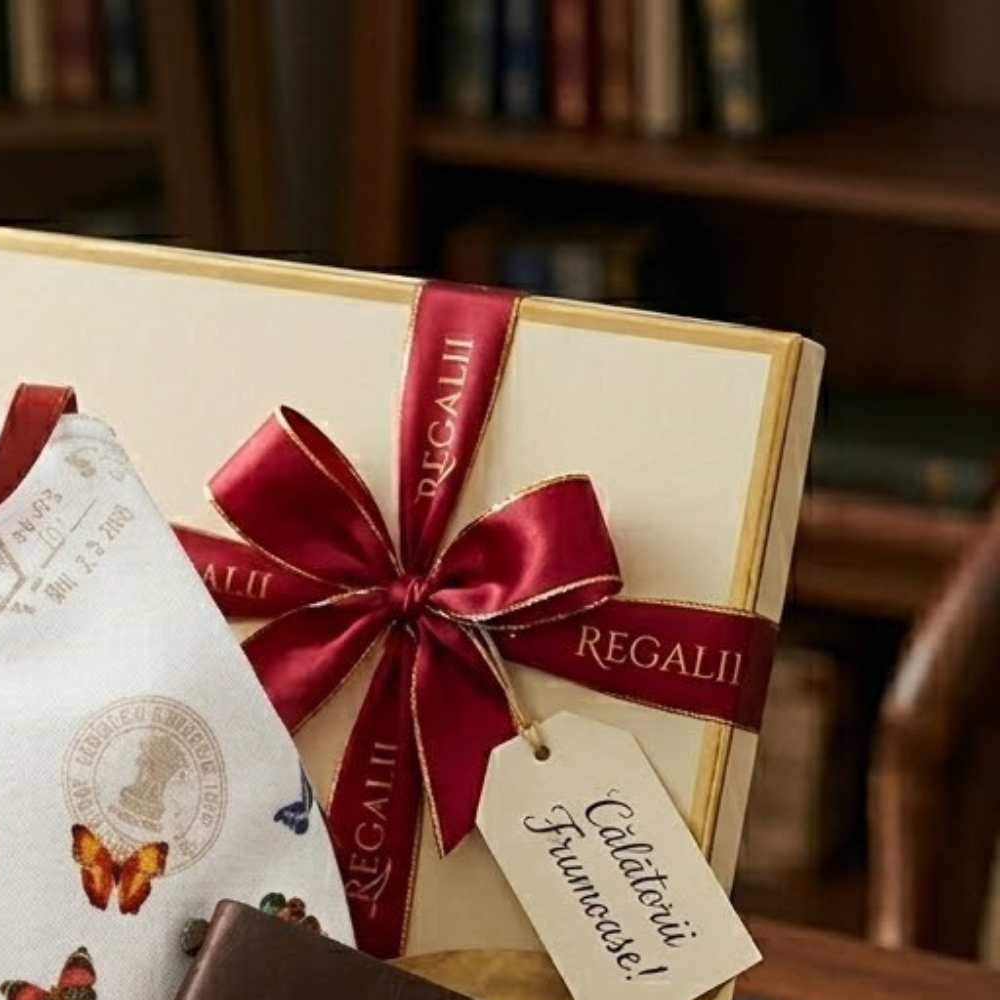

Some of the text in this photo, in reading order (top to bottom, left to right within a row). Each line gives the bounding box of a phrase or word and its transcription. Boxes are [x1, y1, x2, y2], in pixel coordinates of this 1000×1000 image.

[414, 338, 474, 503] REGALII
[203, 563, 273, 599] ALII
[574, 624, 742, 686] REGALII
[346, 741, 398, 918] REGALII
[523, 804, 669, 981] Frumoase!
